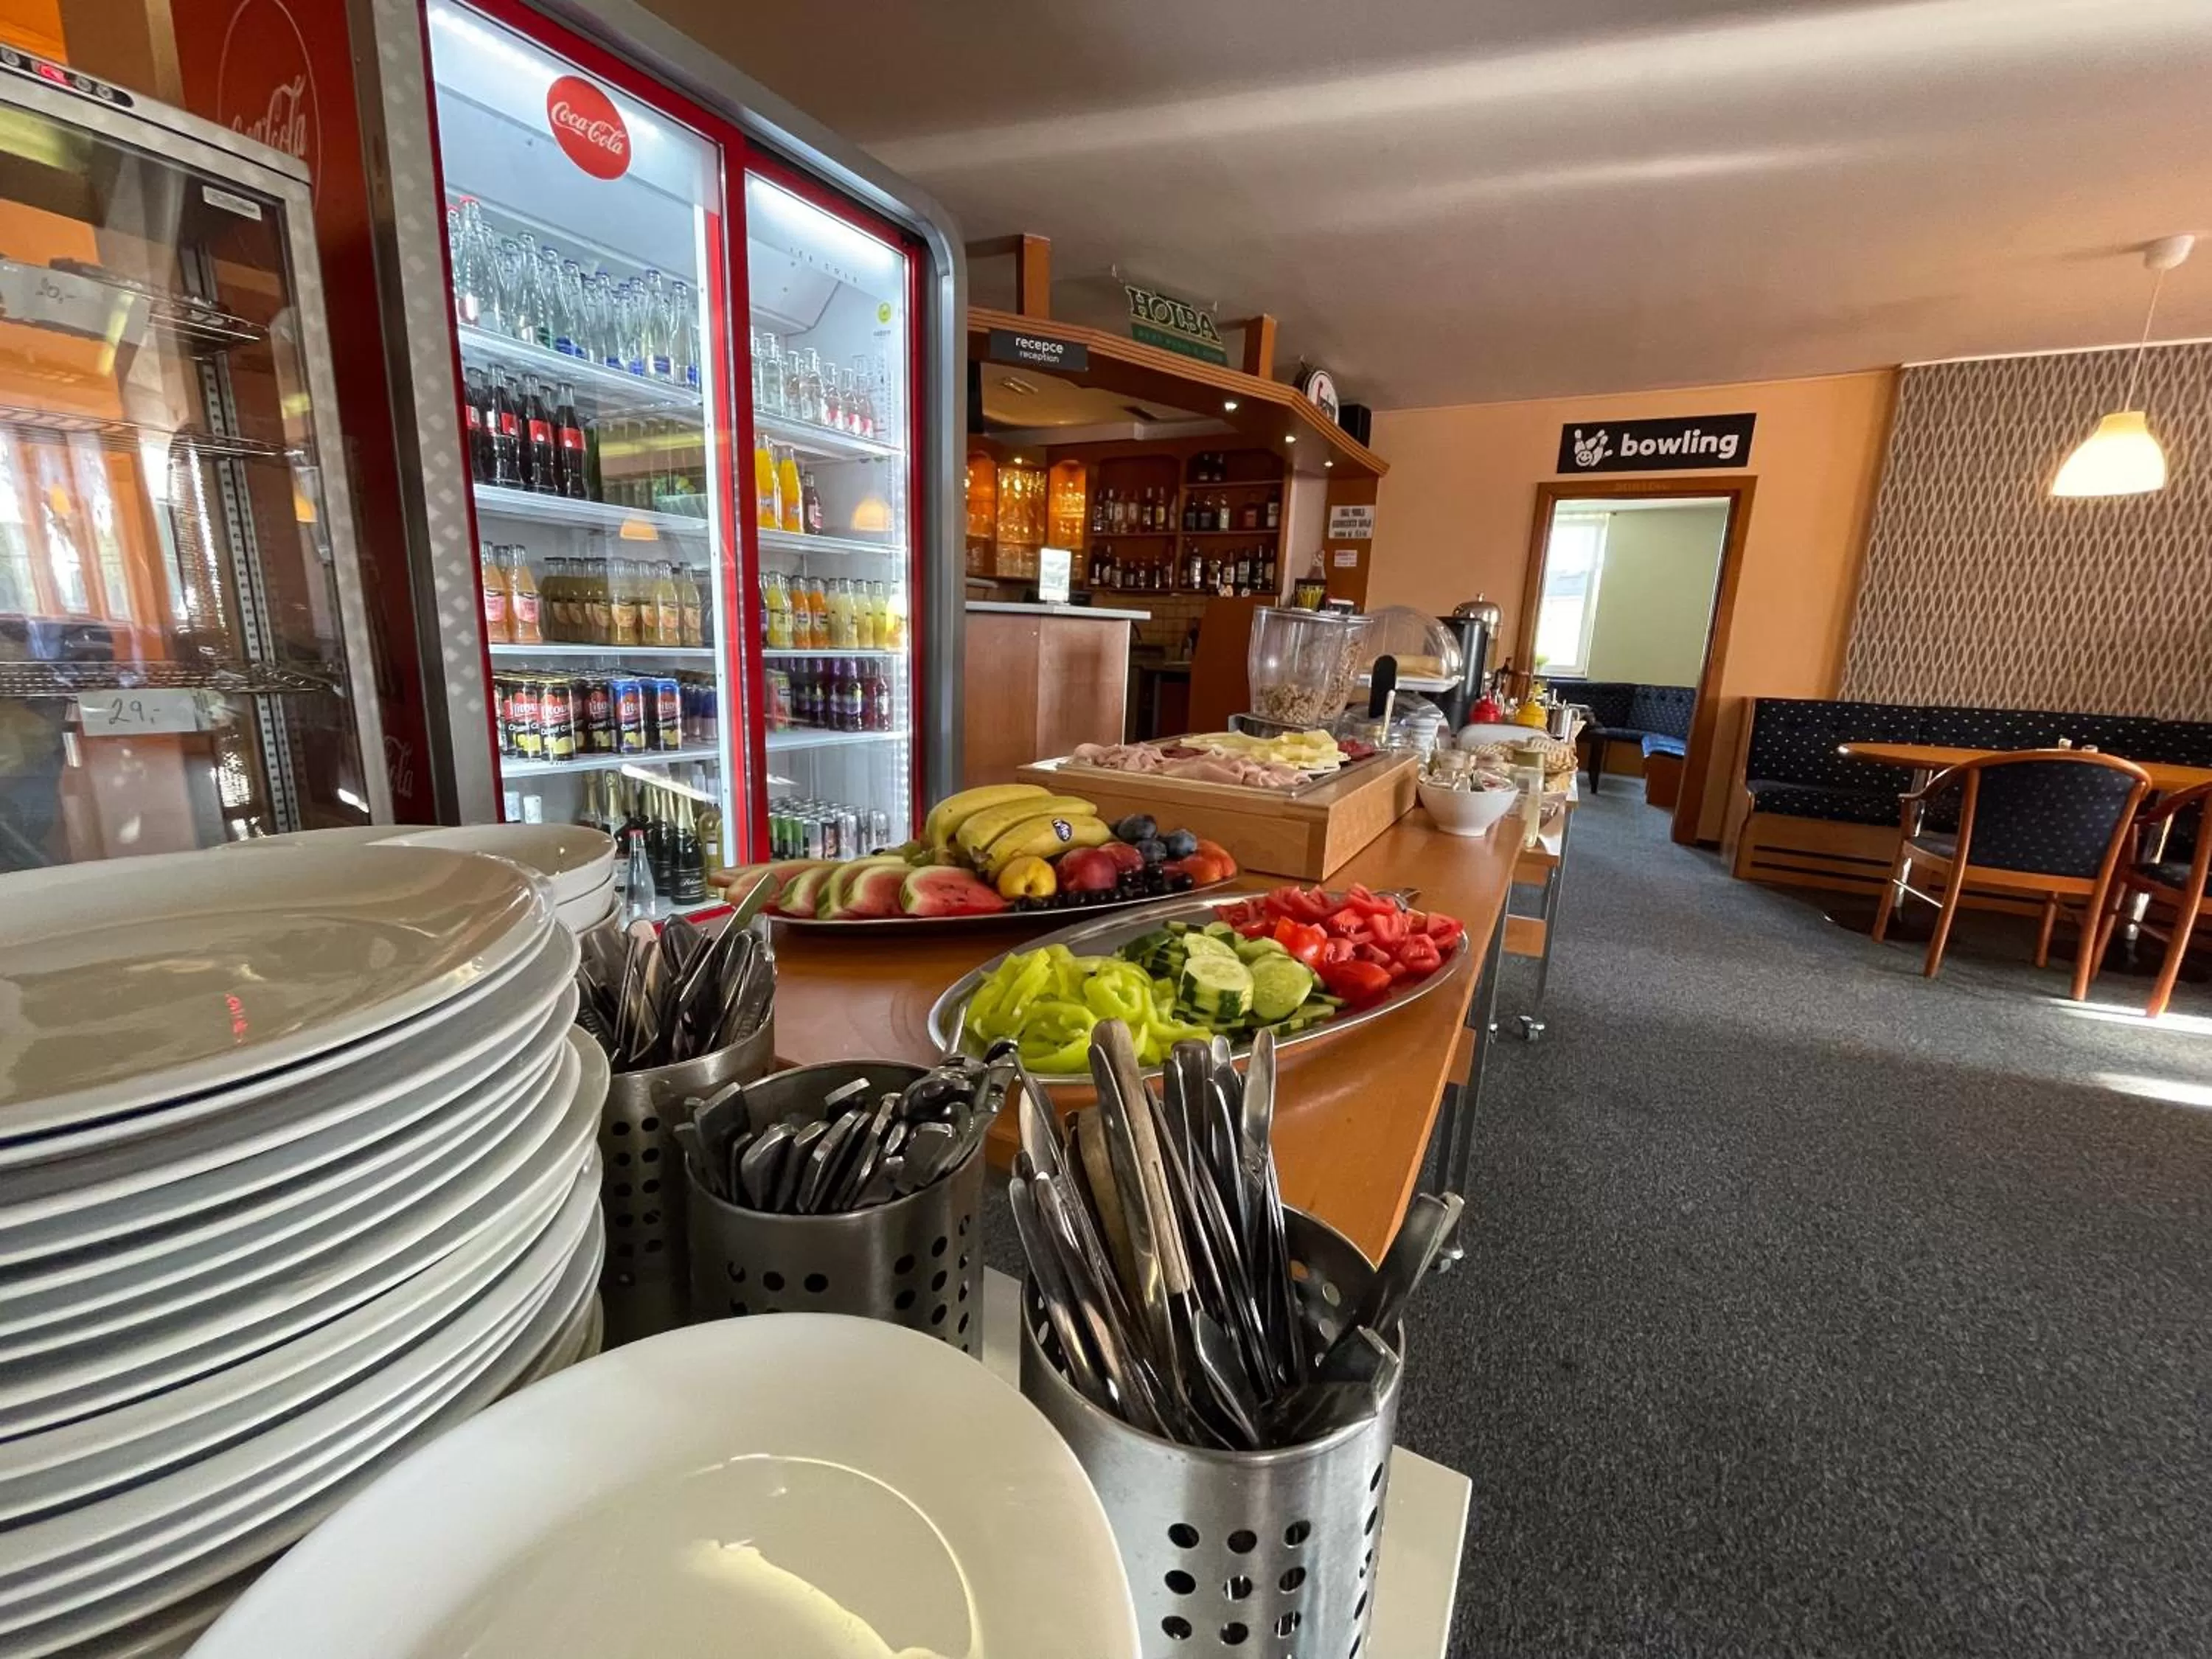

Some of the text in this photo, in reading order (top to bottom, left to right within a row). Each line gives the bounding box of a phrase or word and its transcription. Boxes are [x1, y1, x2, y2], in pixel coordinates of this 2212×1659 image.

[551, 101, 626, 154] Coca-Cola
[1125, 285, 1222, 344] HOLBA
[1015, 337, 1064, 353] recepce
[1019, 350, 1060, 363] reception
[1621, 428, 1739, 459] bowling
